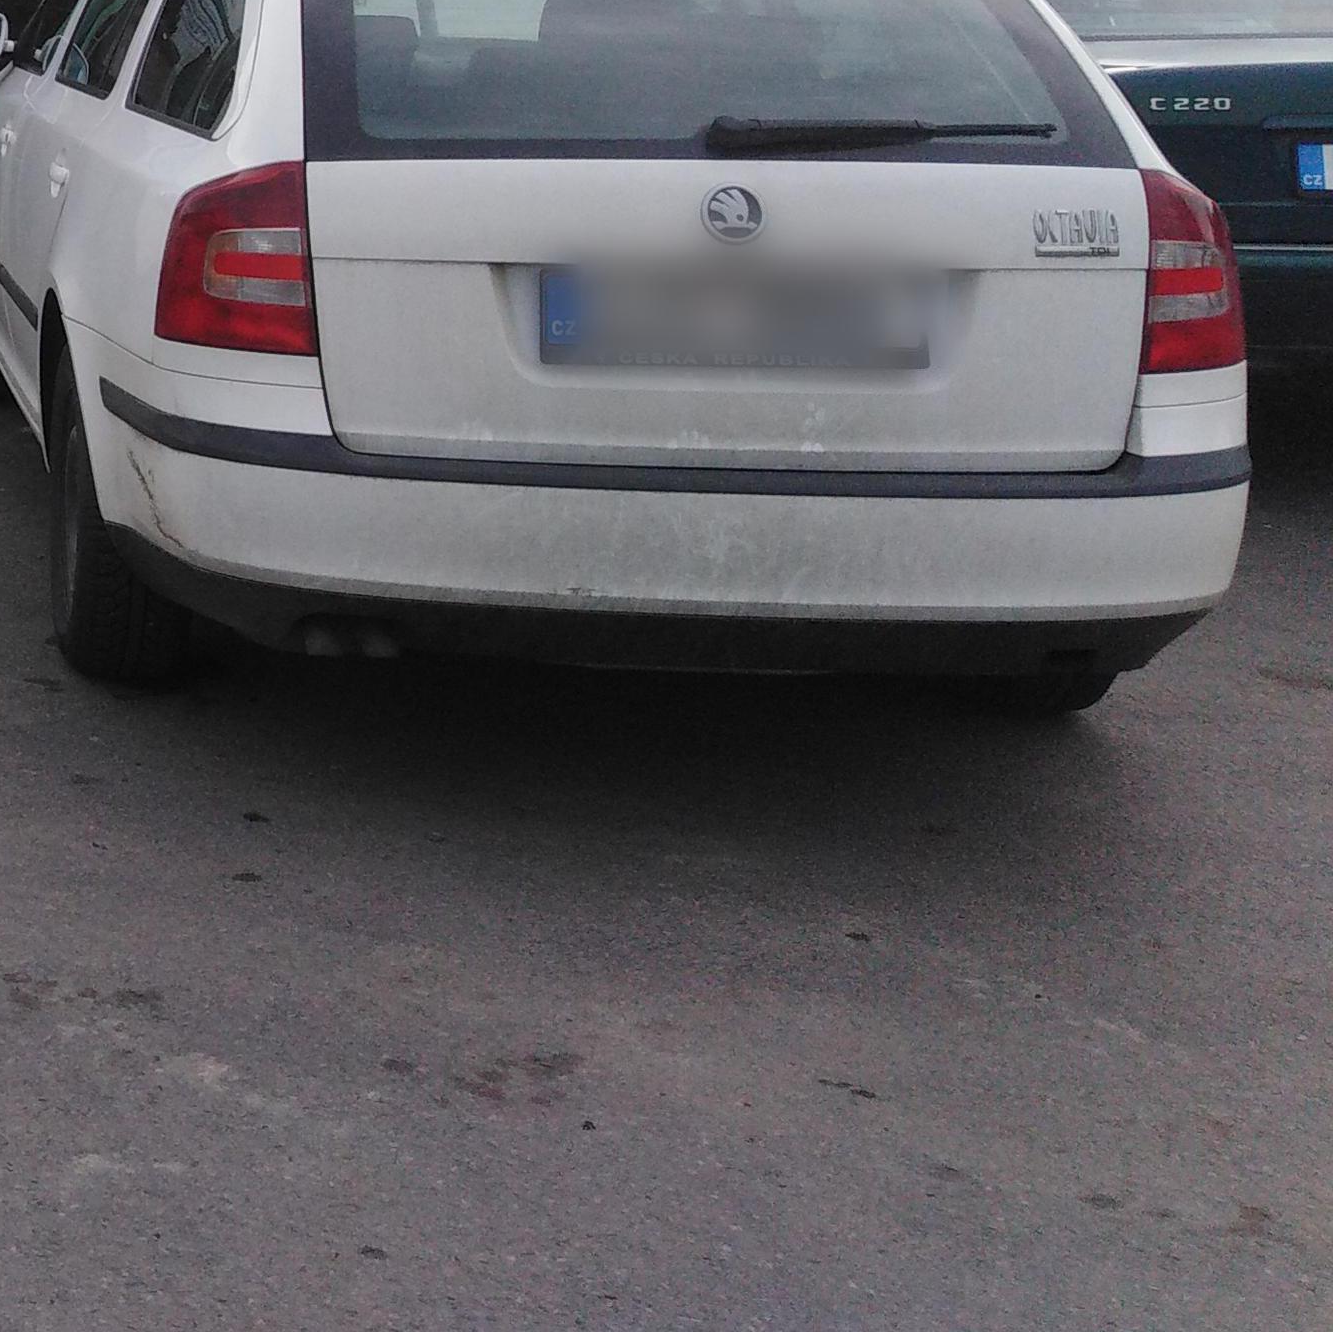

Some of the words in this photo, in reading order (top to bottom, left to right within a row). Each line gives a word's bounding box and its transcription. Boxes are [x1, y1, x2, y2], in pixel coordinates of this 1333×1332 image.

[1150, 97, 1166, 110] C
[1173, 97, 1231, 111] 220
[1303, 174, 1323, 186] CZ
[1033, 209, 1119, 244] OCTAVIA
[551, 320, 576, 336] CZ
